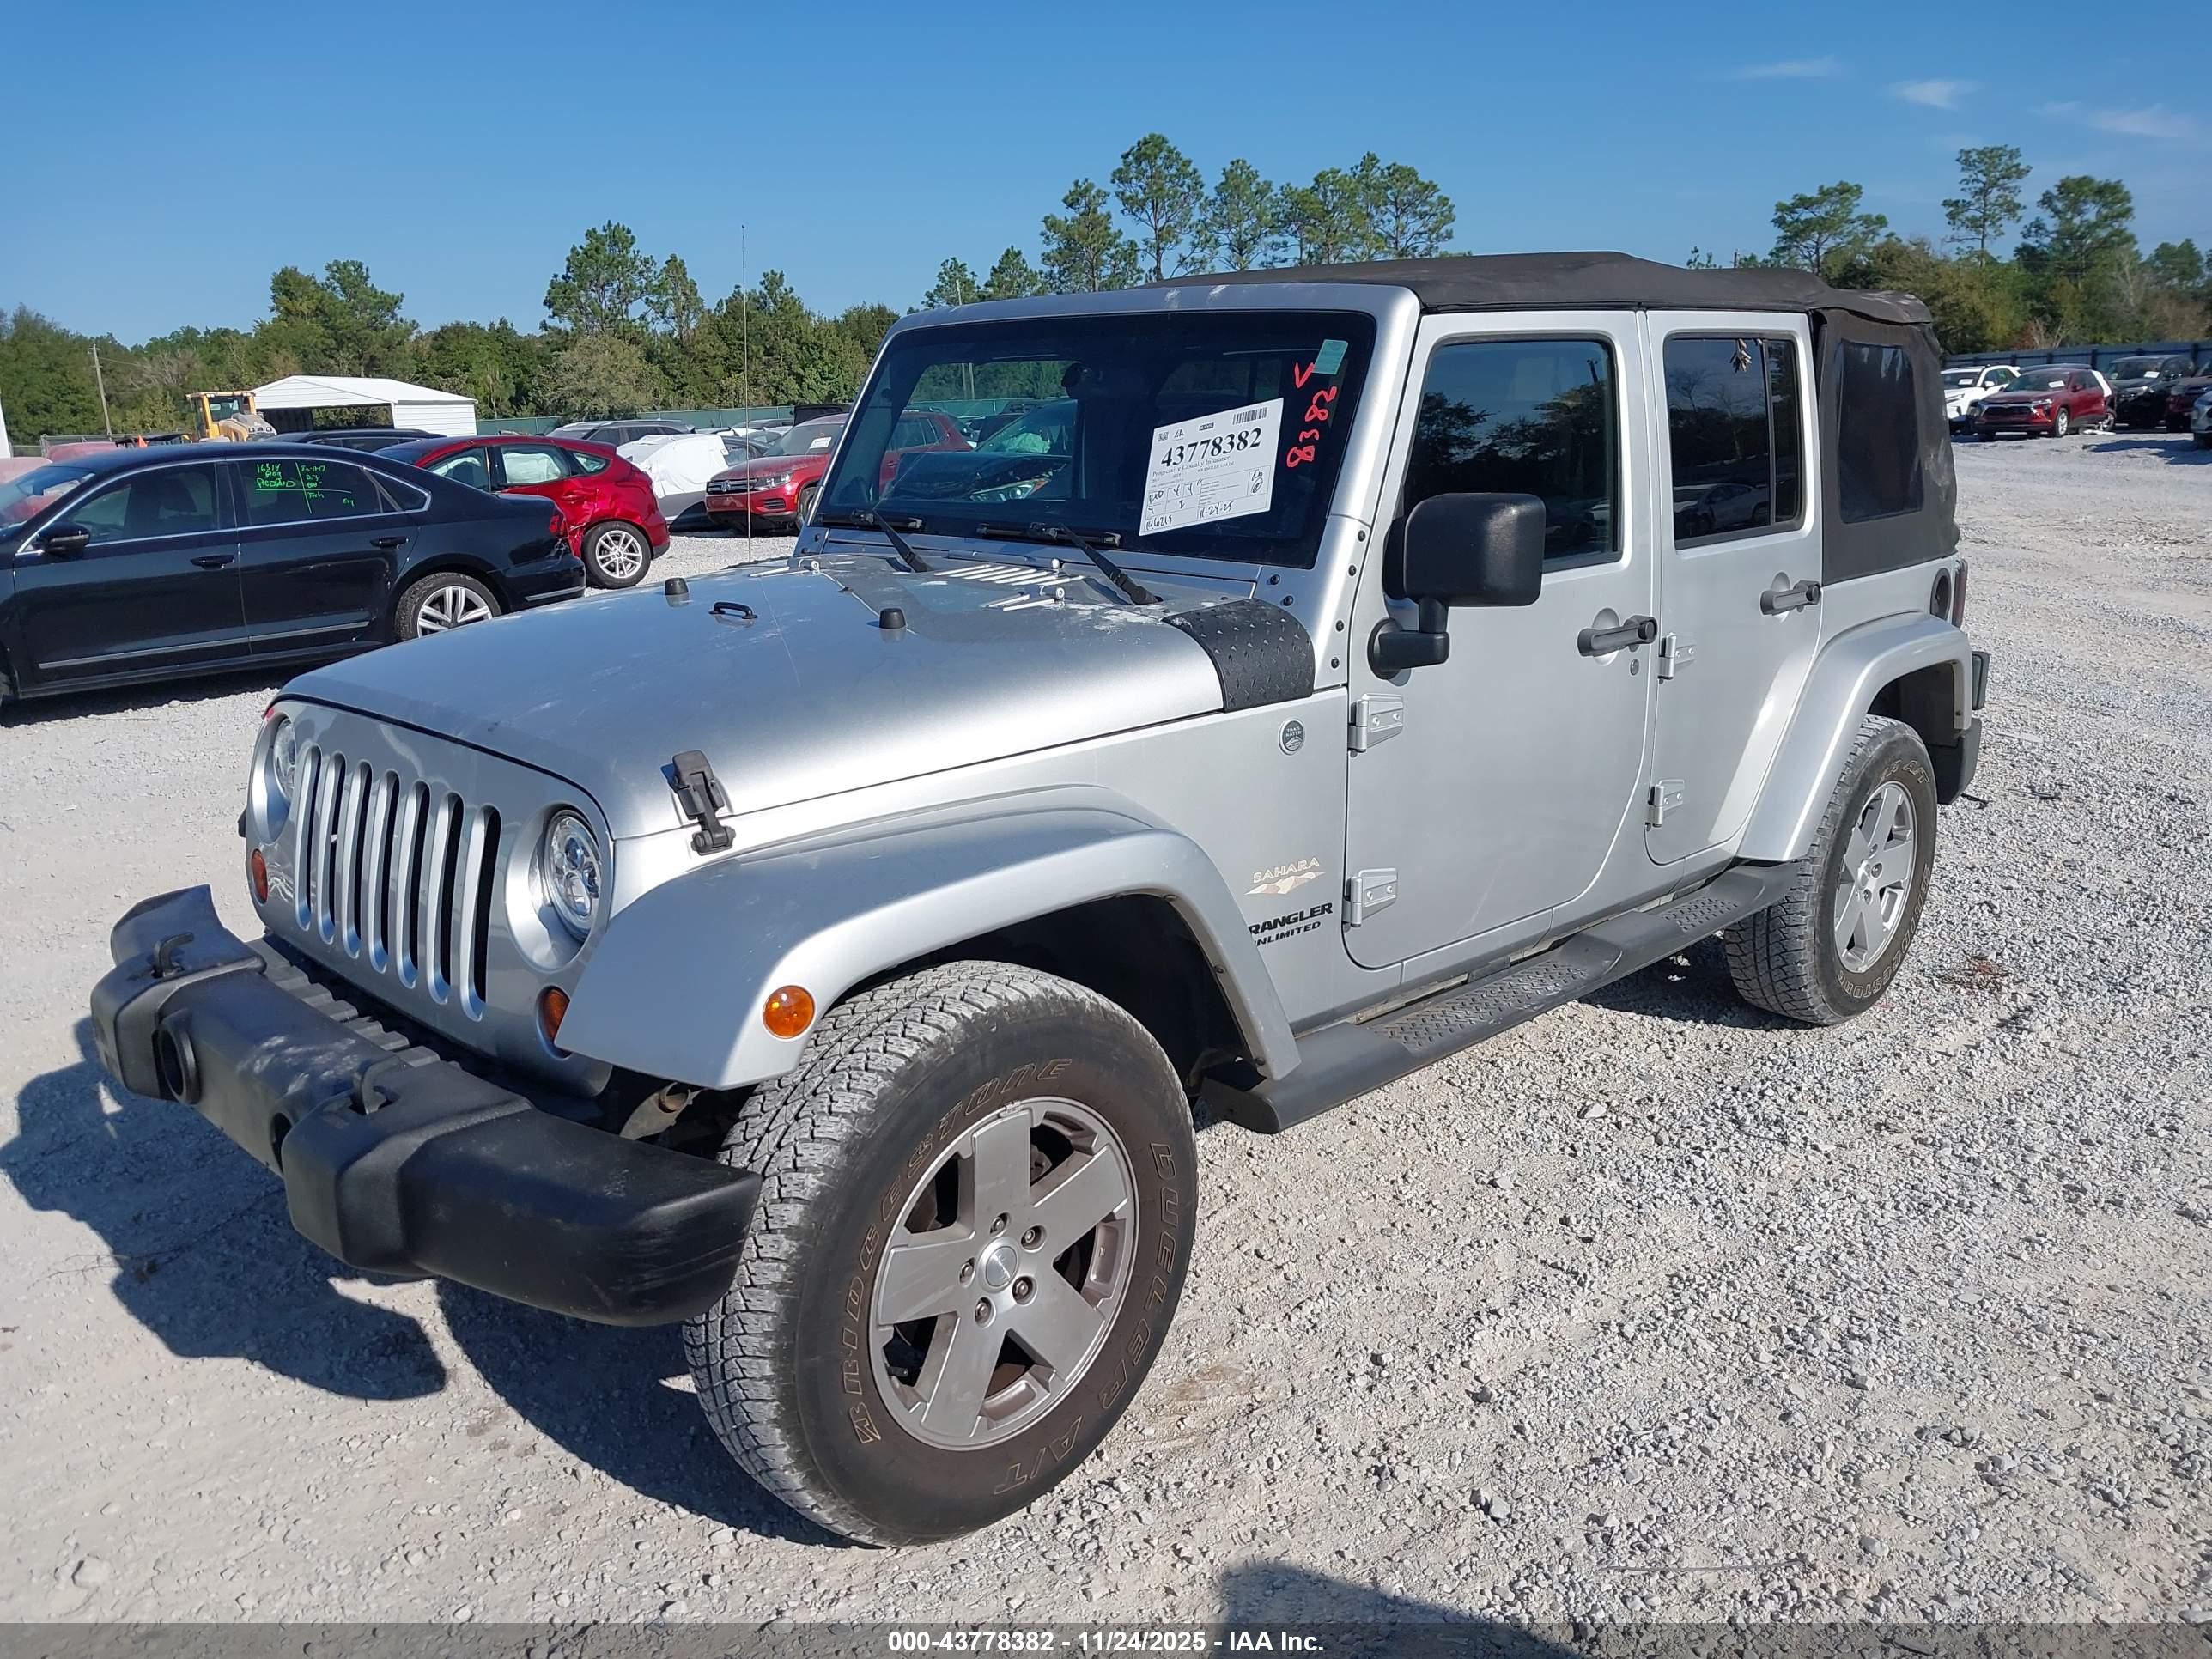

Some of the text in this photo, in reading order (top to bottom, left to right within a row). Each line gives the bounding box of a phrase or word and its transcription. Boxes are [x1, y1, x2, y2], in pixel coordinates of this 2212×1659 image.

[1286, 386, 1338, 468] 8382
[1161, 428, 1261, 467] 43778382
[1206, 455, 1231, 465] Insurance
[1253, 857, 1320, 883] SAHARA
[1249, 902, 1333, 934] RANGLER
[1255, 921, 1321, 946] NLIMITED
[840, 1059, 1073, 1443] BRIDGESTONE
[994, 1142, 1178, 1495] DUELER A/T
